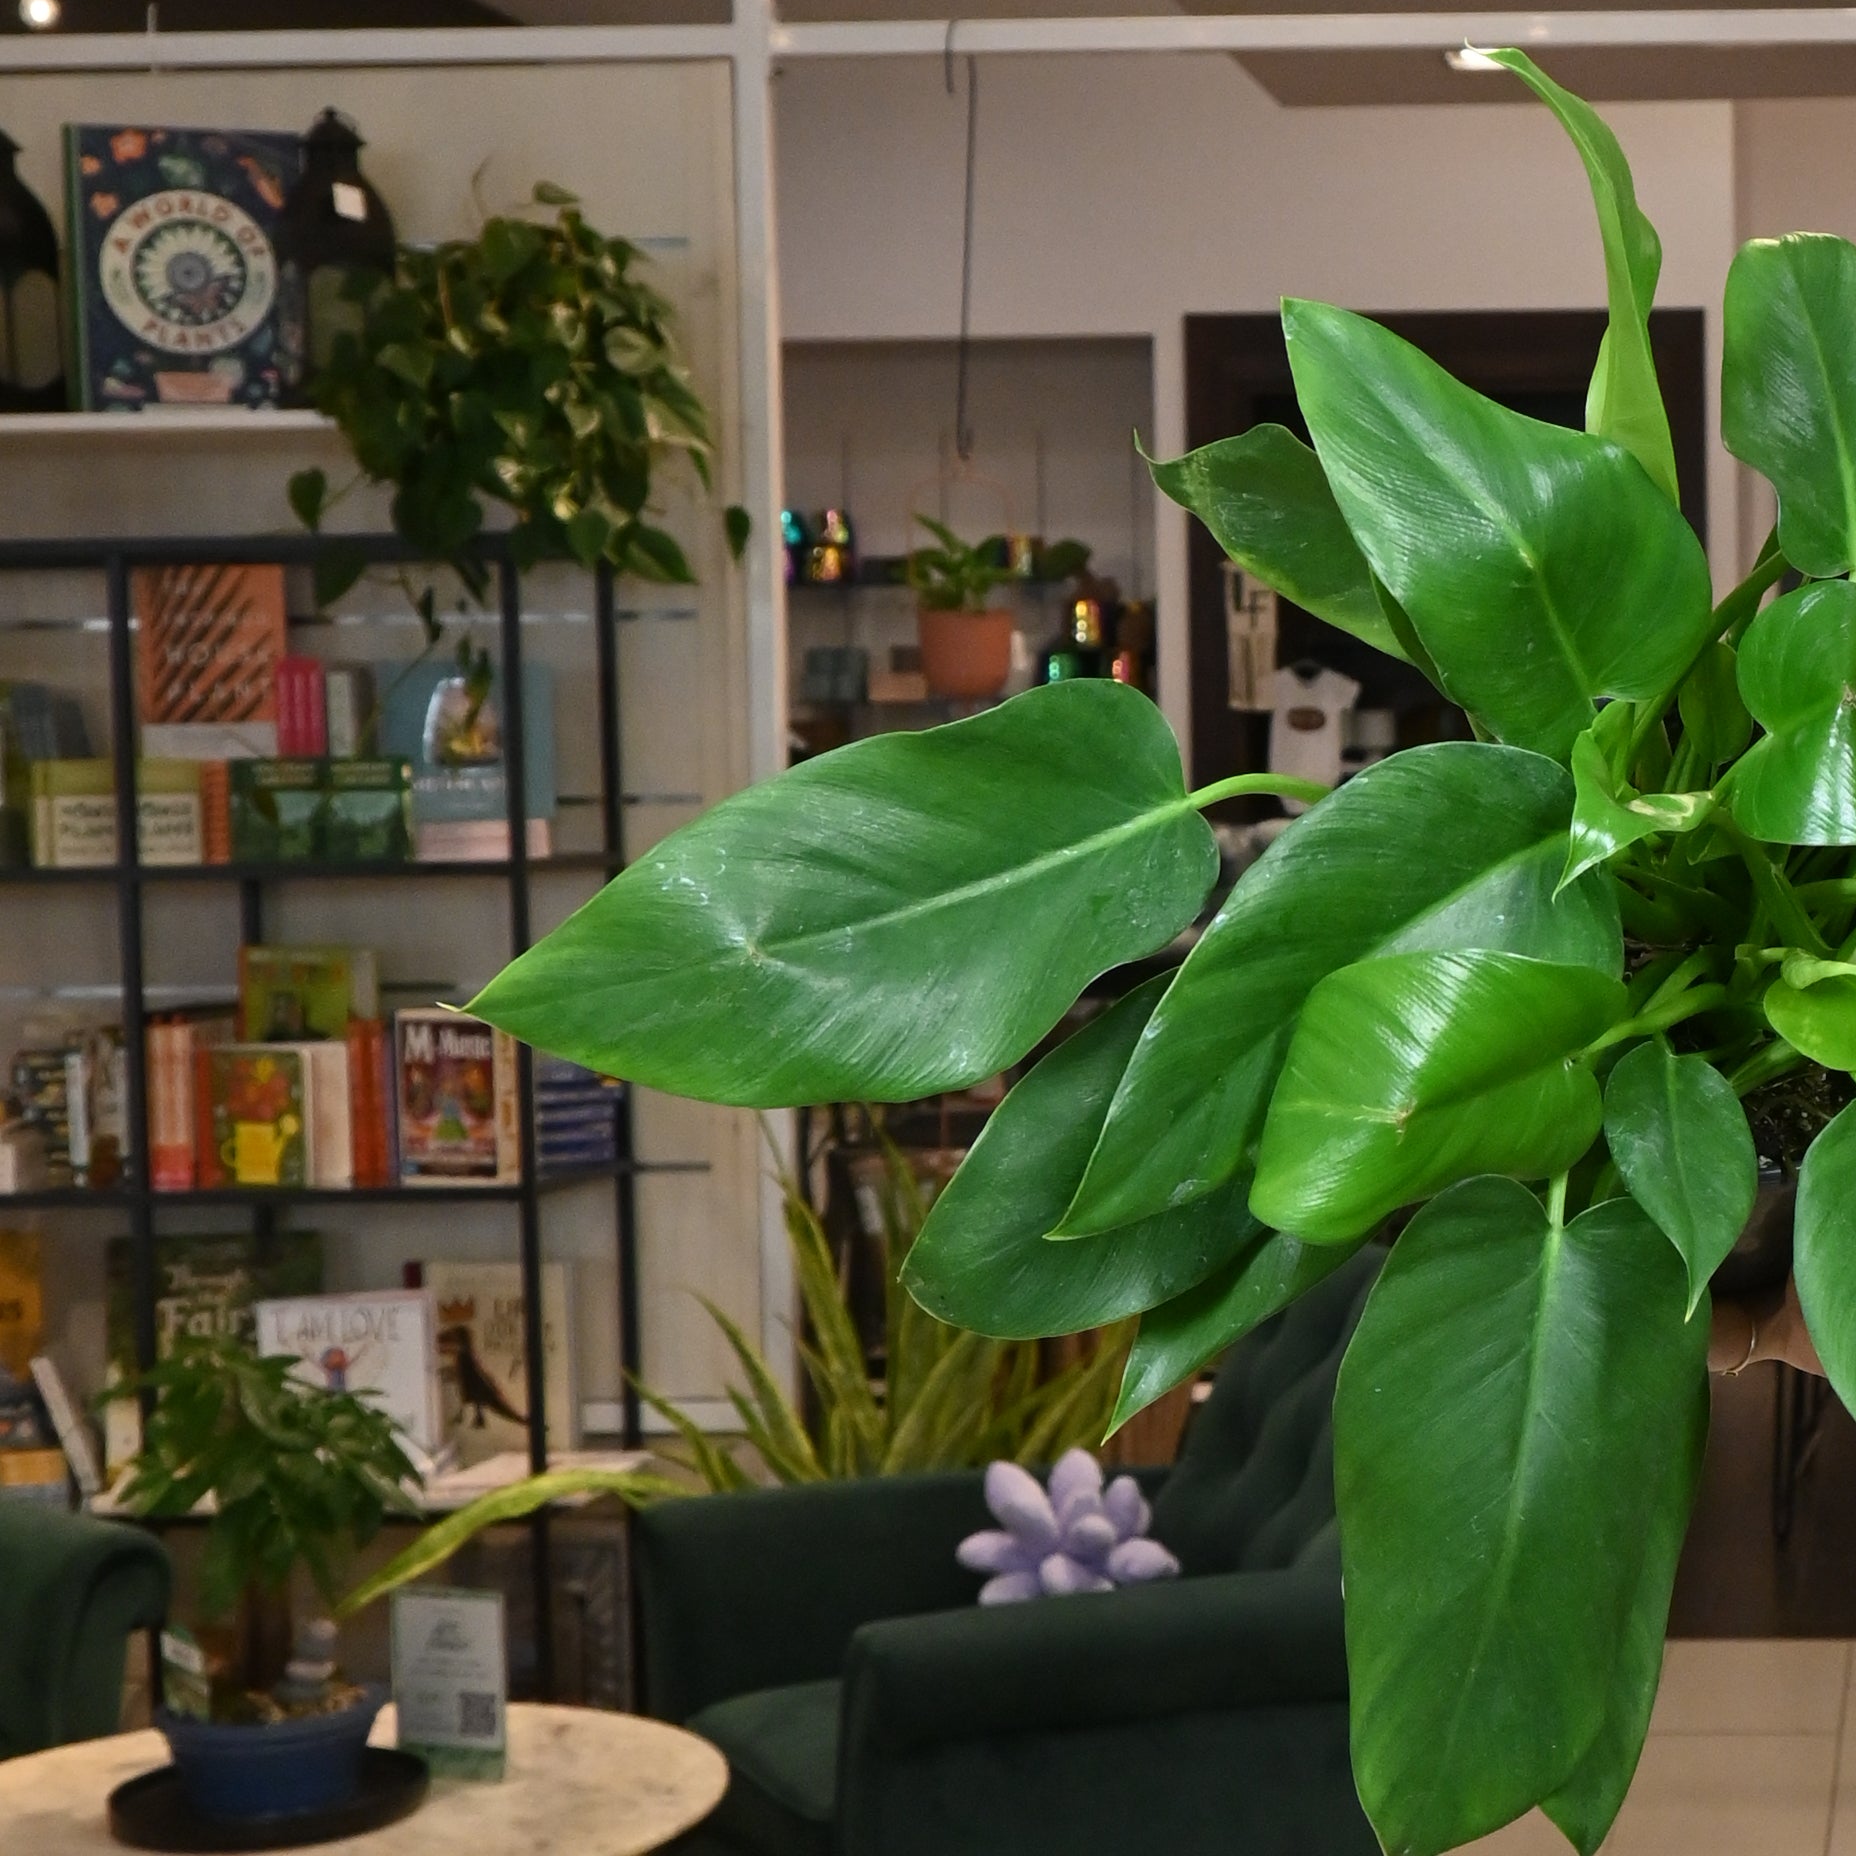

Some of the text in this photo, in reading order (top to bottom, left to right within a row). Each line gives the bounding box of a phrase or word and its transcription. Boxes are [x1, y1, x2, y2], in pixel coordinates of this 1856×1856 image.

[130, 196, 231, 229] WORLD
[235, 226, 267, 257] OF
[142, 317, 247, 346] PLANTS
[340, 1303, 402, 1341] LOVE
